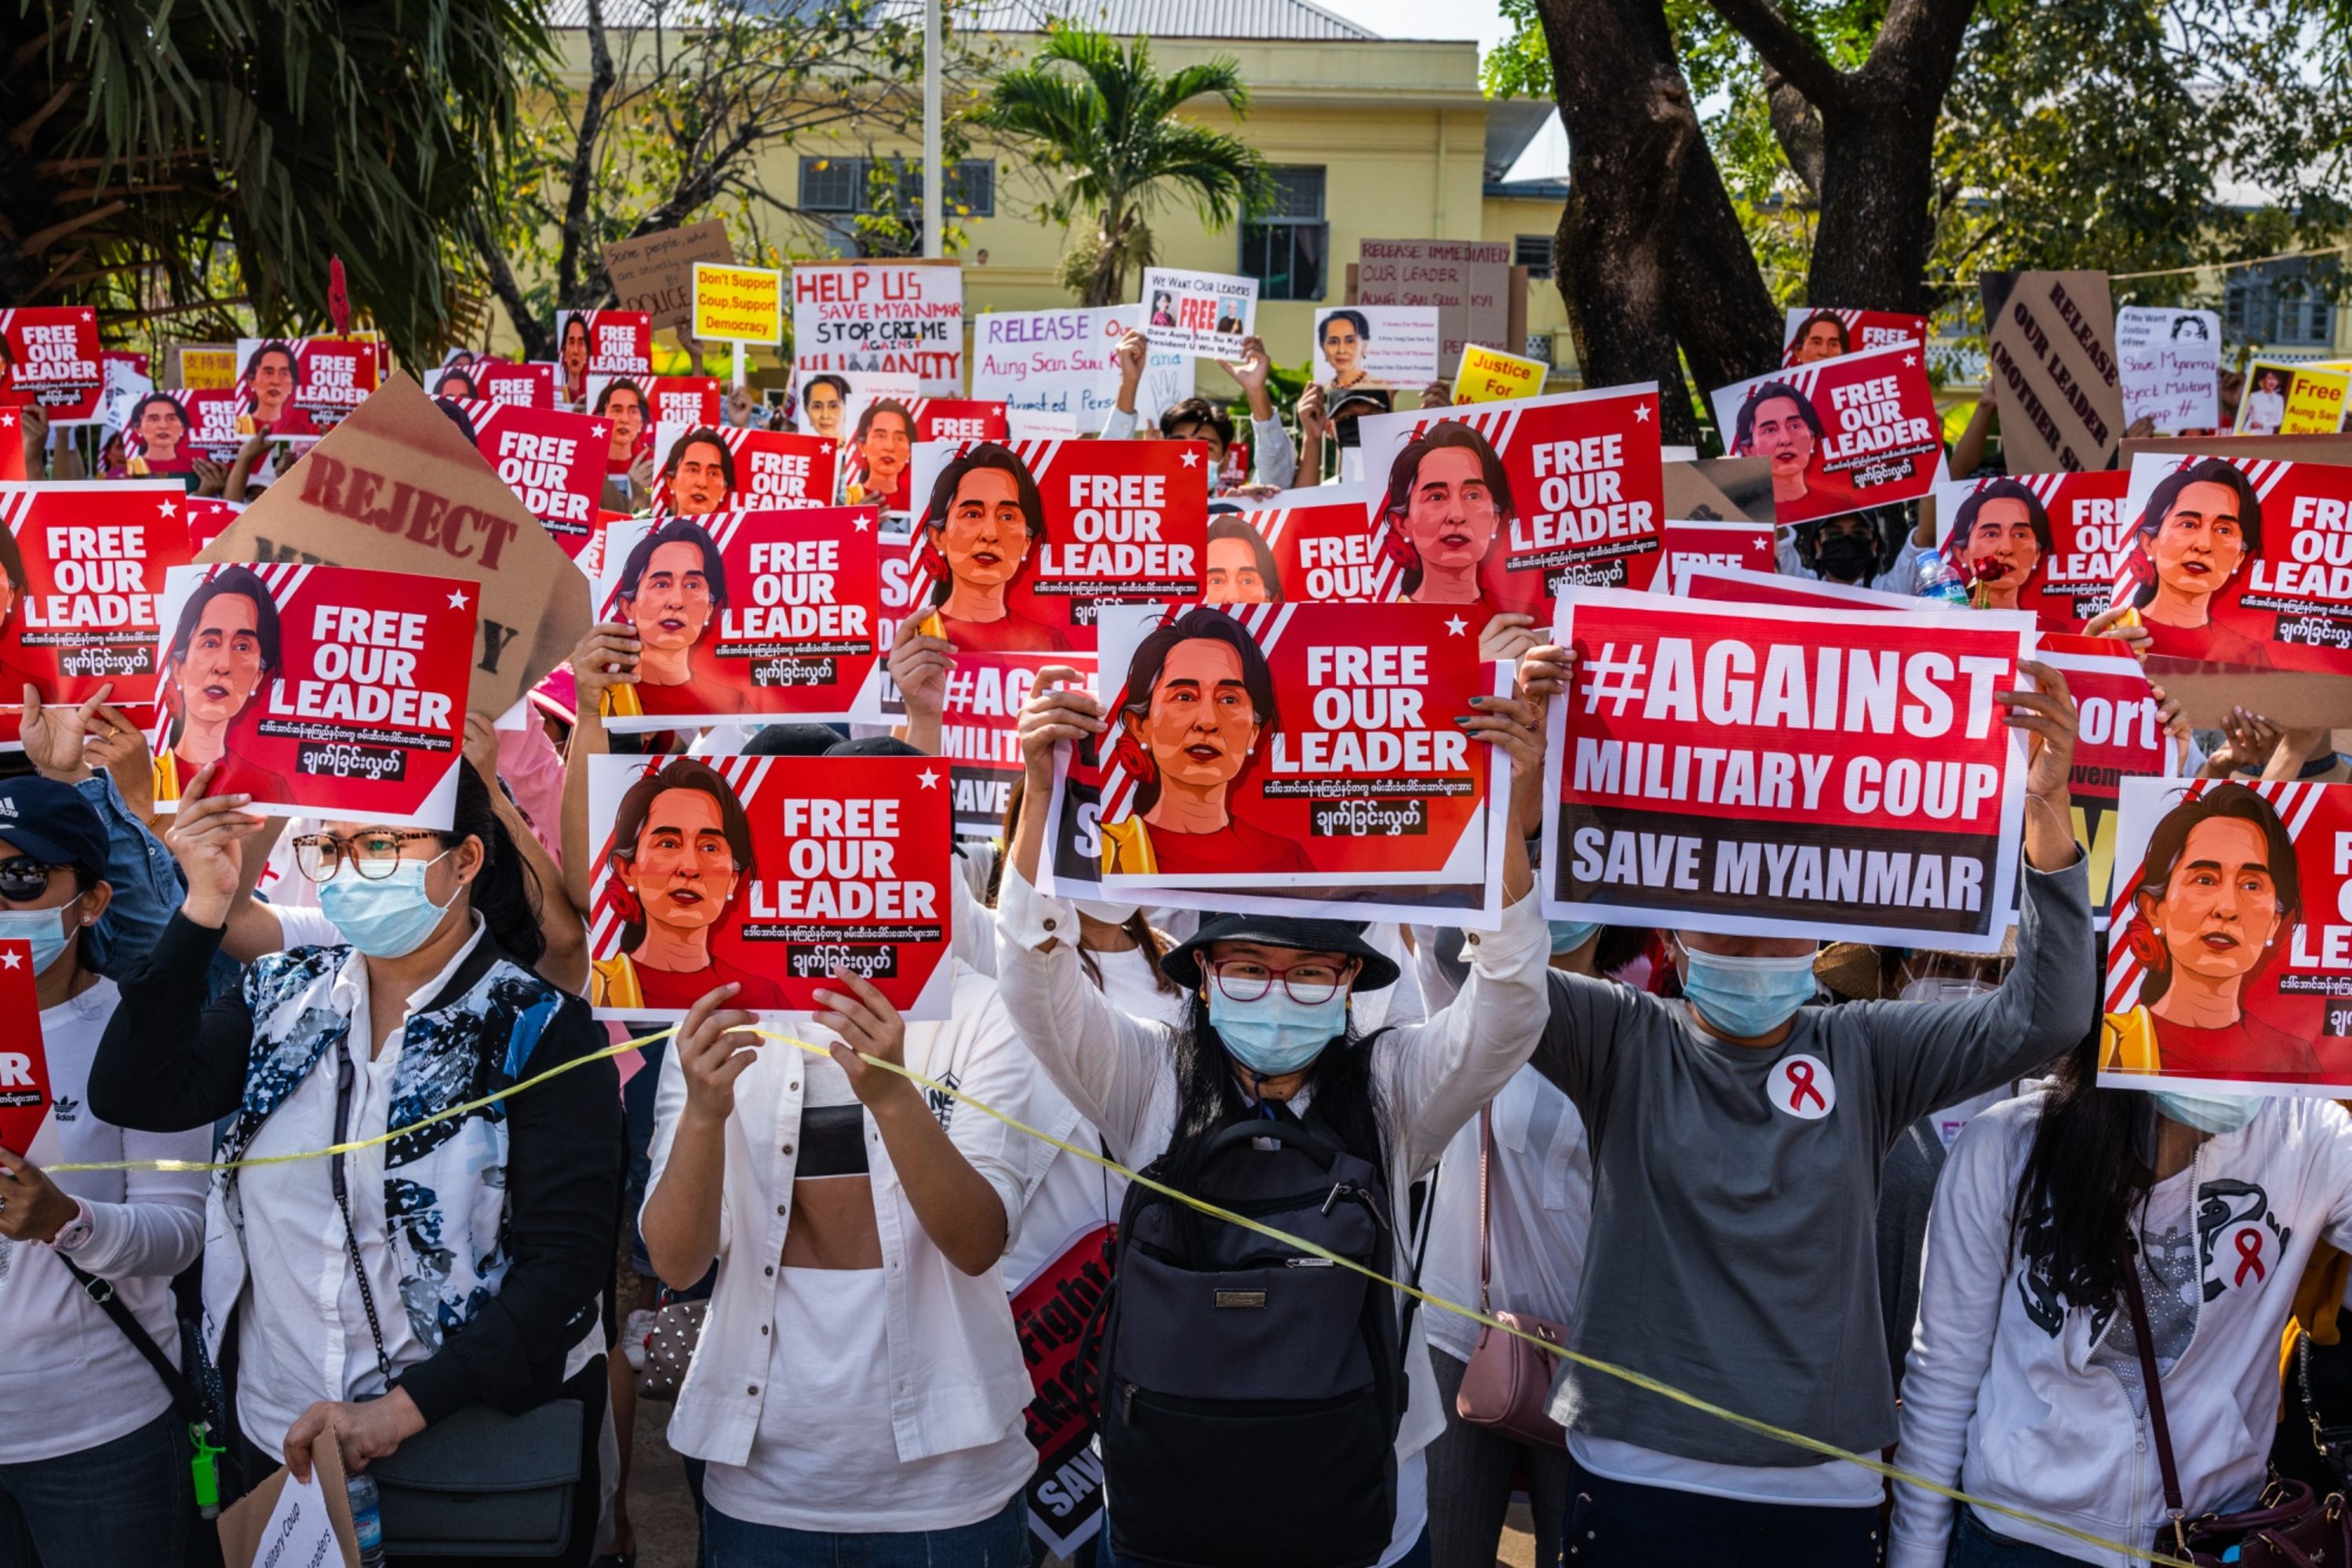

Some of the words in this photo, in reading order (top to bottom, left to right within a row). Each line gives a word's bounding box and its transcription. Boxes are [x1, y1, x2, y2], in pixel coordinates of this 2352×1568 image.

[1362, 242, 1422, 259] RELEASE
[699, 271, 729, 286] Don't
[732, 274, 777, 291] Support
[796, 271, 869, 303] HELP
[883, 271, 921, 301] US
[1362, 265, 1396, 282] OUR
[1403, 267, 1459, 282] LEADER
[627, 286, 692, 315] POLICE
[819, 304, 869, 320] SAVE
[875, 302, 963, 319] MYANMAR
[1400, 292, 1428, 306] SAN
[1471, 295, 1493, 307] KYI
[706, 315, 768, 336] Democracy
[988, 315, 1090, 344] RELEASE
[1179, 297, 1218, 335] FREE
[2122, 326, 2150, 335] Justice
[21, 325, 77, 344] FREE
[599, 325, 636, 342] FREE
[600, 340, 635, 357] OUR
[817, 321, 875, 344] STOP
[879, 321, 948, 340] CRIME
[861, 339, 923, 351] AGAINST
[1146, 338, 1186, 349] President
[1147, 328, 1166, 337] Daw
[1169, 330, 1191, 340] Aung
[1194, 333, 1211, 342] San
[1862, 326, 1908, 344] FREE
[2048, 281, 2118, 388] RELEASE
[28, 344, 77, 361] OUR
[310, 355, 356, 373] FREE
[589, 355, 648, 373] LEADER
[982, 354, 1027, 380] Aung
[1032, 352, 1066, 373] San
[1150, 353, 1181, 366] and
[1473, 355, 1531, 380] Justice
[2124, 356, 2157, 372] Save
[12, 361, 97, 381] LEADER
[311, 370, 354, 387] OUR
[490, 378, 534, 395] FREE
[2013, 301, 2048, 361] OUR
[2046, 353, 2109, 448] LEADER
[659, 392, 702, 409] FREE
[1485, 379, 1513, 398] For
[1830, 375, 1901, 410] FREE
[2295, 379, 2341, 401] Free
[198, 401, 235, 415] FRE
[661, 407, 701, 424] OUR
[1840, 399, 1904, 432] OUR
[2288, 406, 2315, 420] Aung
[2318, 409, 2338, 421] San
[931, 417, 985, 437] FREE
[1822, 417, 1932, 460] LEADER
[498, 431, 577, 465] FREE
[751, 451, 811, 477] FREE
[1532, 434, 1623, 478] FREE
[497, 457, 568, 491] OUR
[752, 472, 806, 497] OUR
[1070, 475, 1166, 508] FREE
[1539, 471, 1623, 512] OUR
[299, 452, 519, 571] REJECT
[1073, 509, 1162, 543] OUR
[1509, 500, 1655, 551] LEADER
[46, 526, 147, 558] FREE
[749, 540, 839, 573] FREE
[1299, 534, 1373, 568] FRE
[1040, 544, 1196, 577] LEADER
[54, 560, 146, 594] OUR
[752, 573, 836, 606] OUR
[24, 594, 162, 627] LEADE
[721, 605, 868, 640] LEADER
[312, 605, 427, 650] FREE
[313, 643, 417, 687] OUR
[1307, 646, 1428, 686] FREE
[269, 678, 452, 729] LEADER
[1582, 637, 2009, 739] #AGAINST
[1313, 688, 1425, 729] OUR
[1272, 730, 1469, 773] LEADER
[1574, 737, 1833, 811] MILITARY
[1843, 756, 1998, 820] COUP
[784, 799, 900, 838] FREE
[788, 839, 896, 879] OUR
[1572, 827, 1702, 890] SAVE
[1713, 840, 1983, 912] MYANMAR
[749, 880, 938, 919] LEADER
[282, 1502, 300, 1537] Coup
